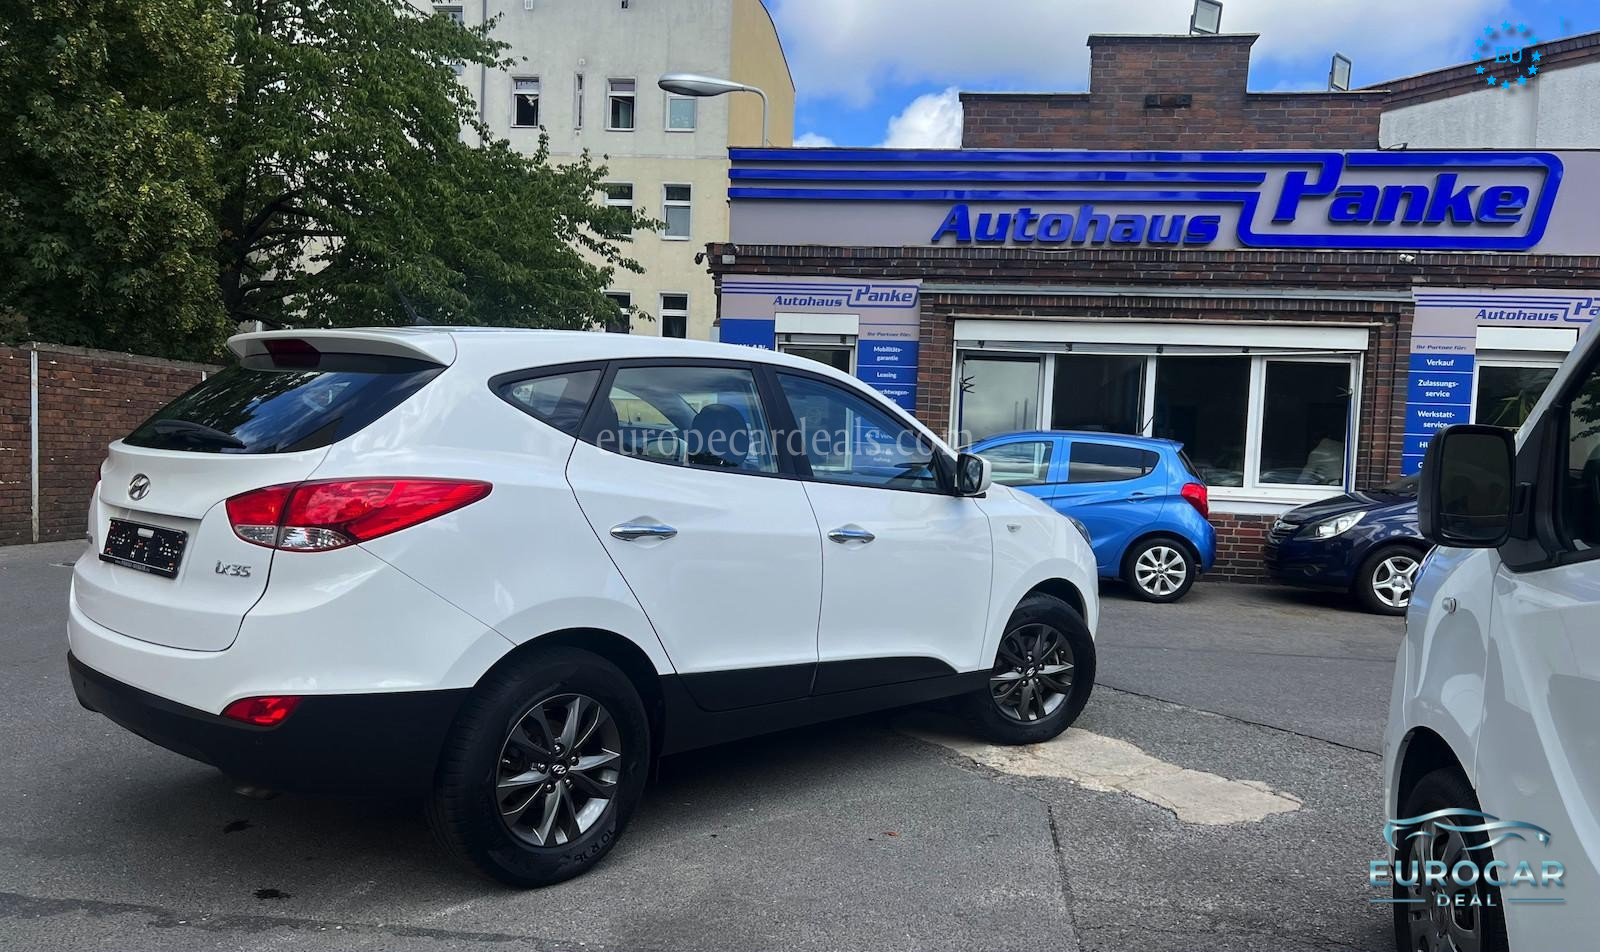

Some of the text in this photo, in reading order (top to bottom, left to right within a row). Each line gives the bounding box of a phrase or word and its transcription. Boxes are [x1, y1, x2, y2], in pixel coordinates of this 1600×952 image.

[931, 156, 1530, 246] Autohaus Panke
[773, 285, 912, 307] Autohaus Panke
[1475, 309, 1559, 322] Autohaus
[873, 345, 903, 353] Mobilitäts-
[876, 354, 899, 362] garantie
[1426, 359, 1455, 367] Verkauf
[876, 371, 897, 379] Leasing
[1417, 379, 1459, 389] Zulassungs-
[1425, 390, 1450, 398] service
[1417, 410, 1456, 418] Werkstatt-
[215, 560, 251, 577] ix35
